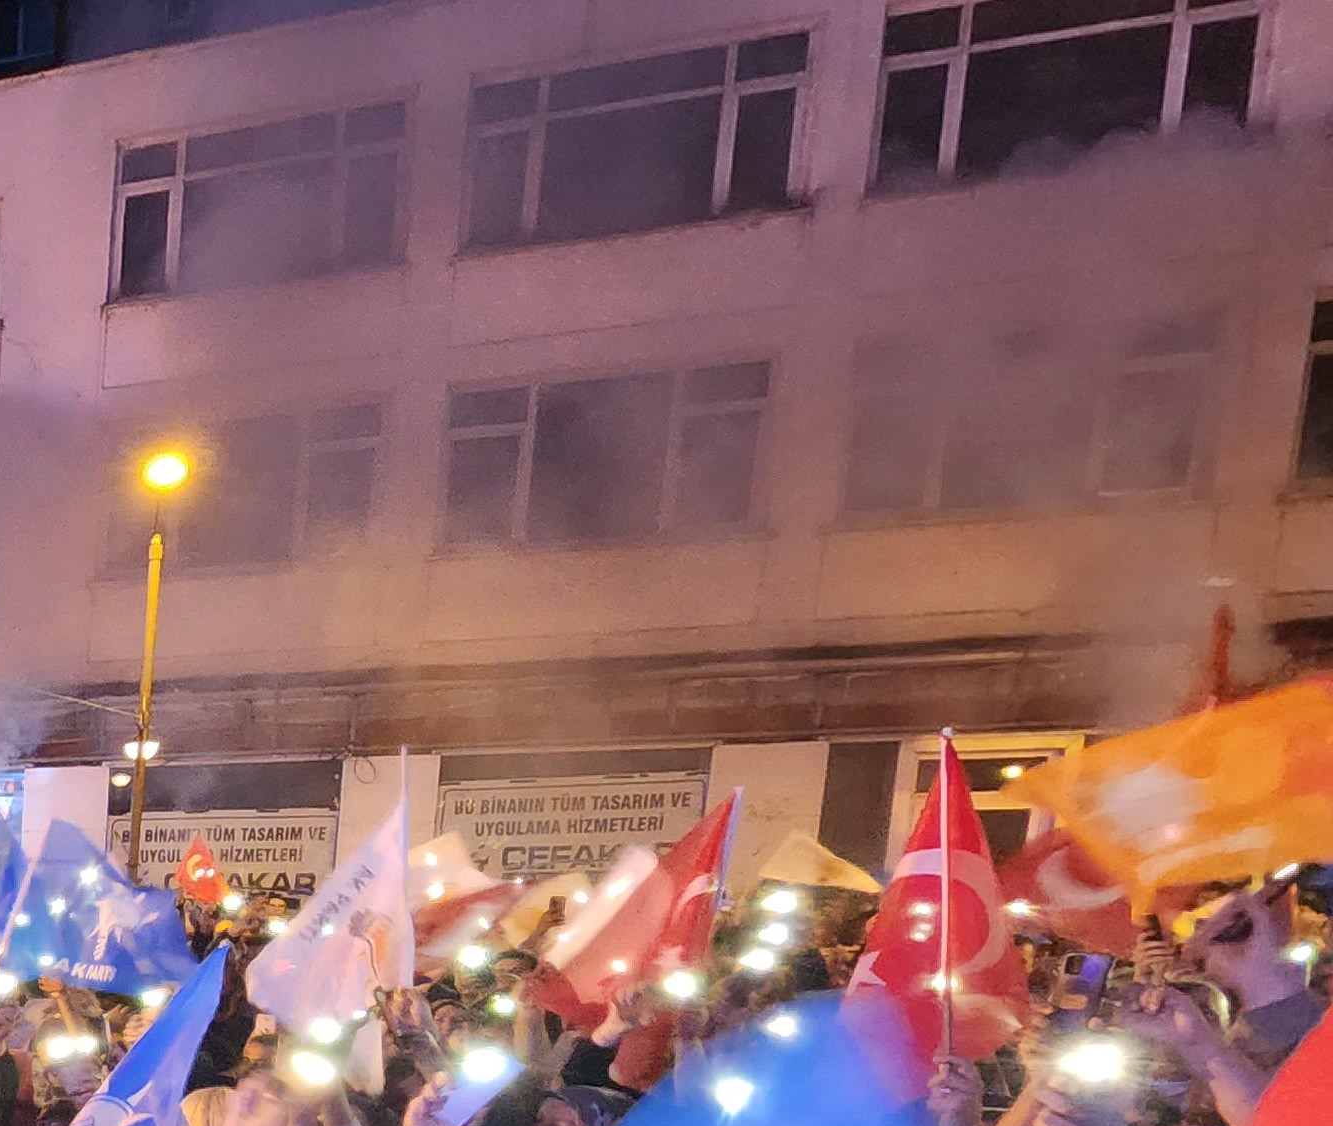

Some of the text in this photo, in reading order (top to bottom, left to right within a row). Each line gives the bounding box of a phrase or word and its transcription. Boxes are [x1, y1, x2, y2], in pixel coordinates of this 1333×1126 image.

[482, 796, 545, 814] BİNANIN
[551, 793, 587, 811] TÜM
[591, 791, 665, 810] TASARIM
[671, 791, 692, 808] VE
[145, 827, 200, 843] BİNANI
[205, 825, 236, 842] TÜM
[241, 826, 303, 843] TASARIM
[308, 826, 327, 841] VE
[474, 815, 665, 837] UYGULAMA HİZMETLERİ
[219, 846, 303, 863] HİZMETLERİ
